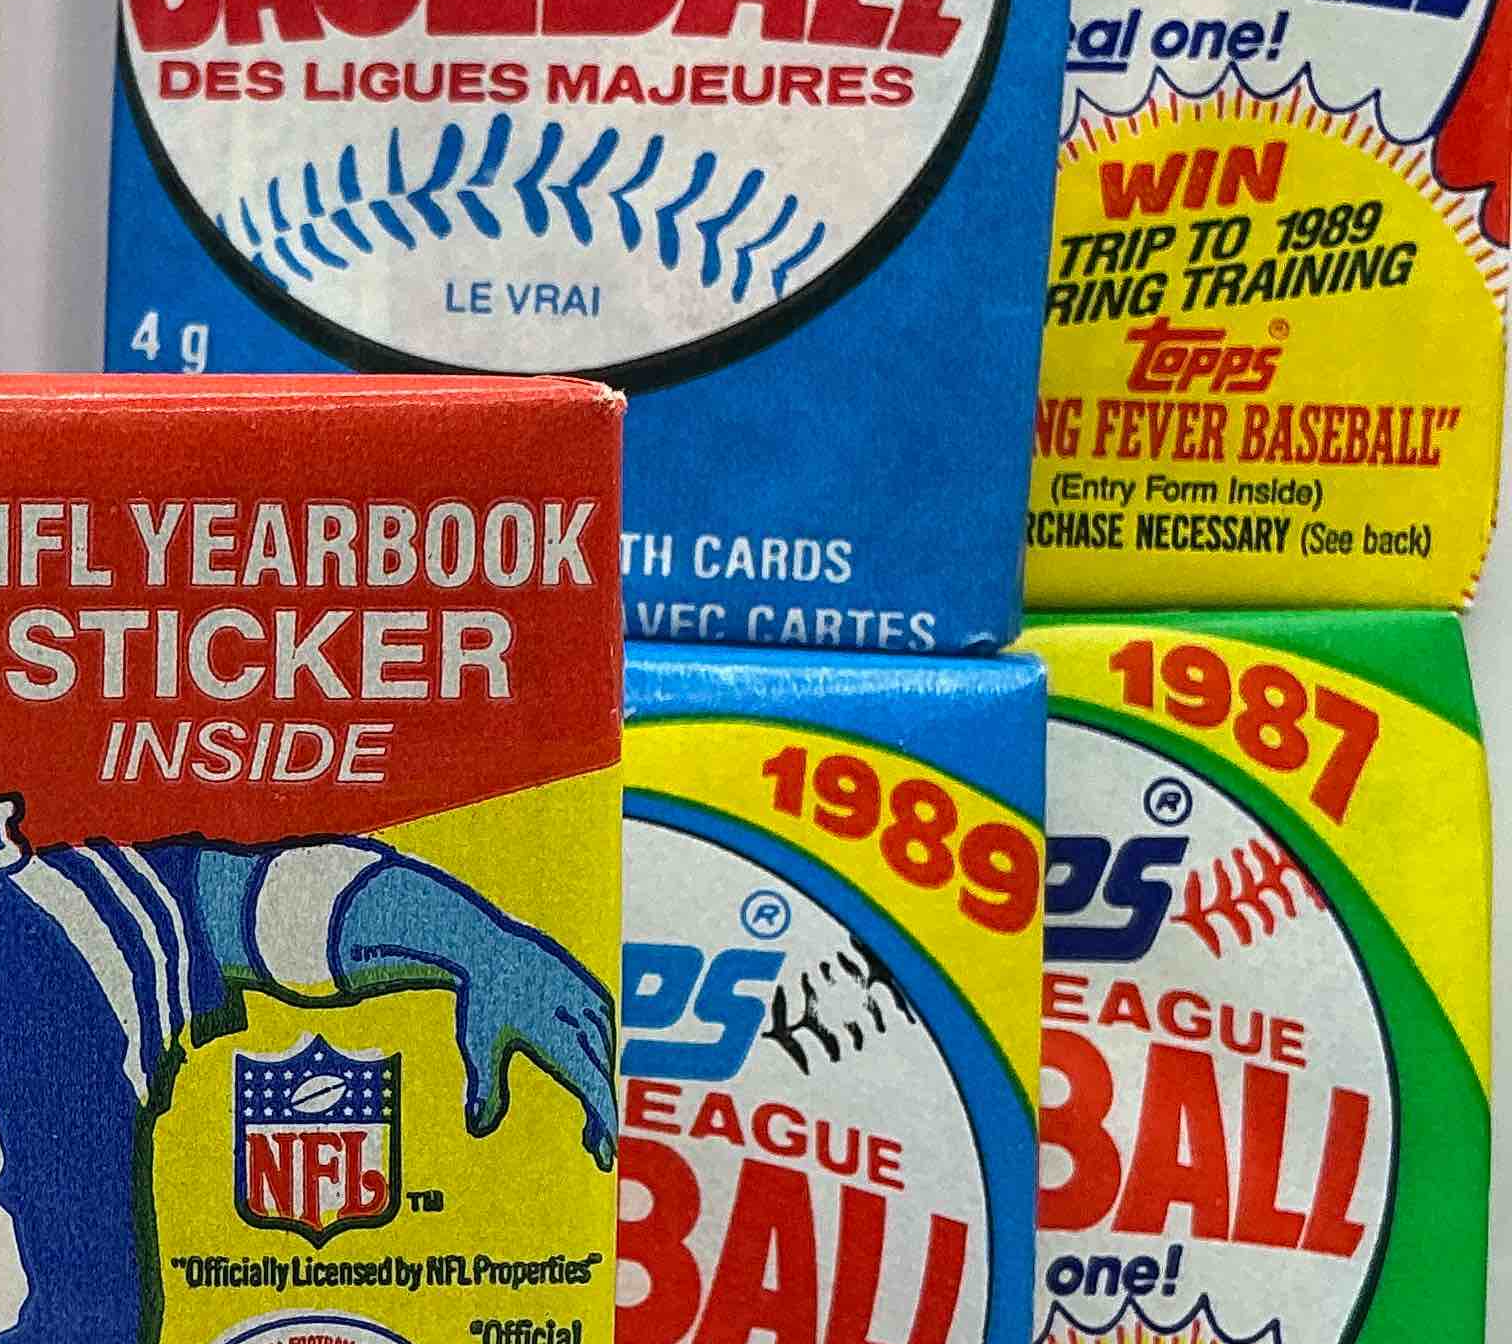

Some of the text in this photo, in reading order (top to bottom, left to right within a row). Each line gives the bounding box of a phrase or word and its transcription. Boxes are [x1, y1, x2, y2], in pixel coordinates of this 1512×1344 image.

[1151, 11, 1289, 60] one!
[158, 60, 915, 107] DES LIGUES MAJEURES
[1100, 141, 1287, 220] WIN
[1060, 200, 1382, 280] TRIP TO 1989
[445, 280, 600, 317] LE VRAI
[1182, 242, 1416, 312] TRAINING
[131, 311, 209, 374] 4 g
[1092, 400, 1227, 463] FEVER
[1051, 475, 1324, 512] (Entry Form Inside)
[129, 499, 598, 591] YEARBOOK
[694, 534, 852, 584] CARDS
[1136, 514, 1431, 558] NECESSARY (See back)
[5, 608, 513, 703] STICKER
[748, 604, 936, 650] CARTES
[100, 720, 393, 786] INSIDE
[1109, 640, 1380, 827] 1987
[762, 747, 1042, 935] 1989
[246, 1131, 388, 1231] NFL
[293, 1256, 391, 1287] Licensed
[395, 1256, 421, 1291] by
[427, 1258, 471, 1285] NFL
[1046, 1243, 1184, 1298] one!
